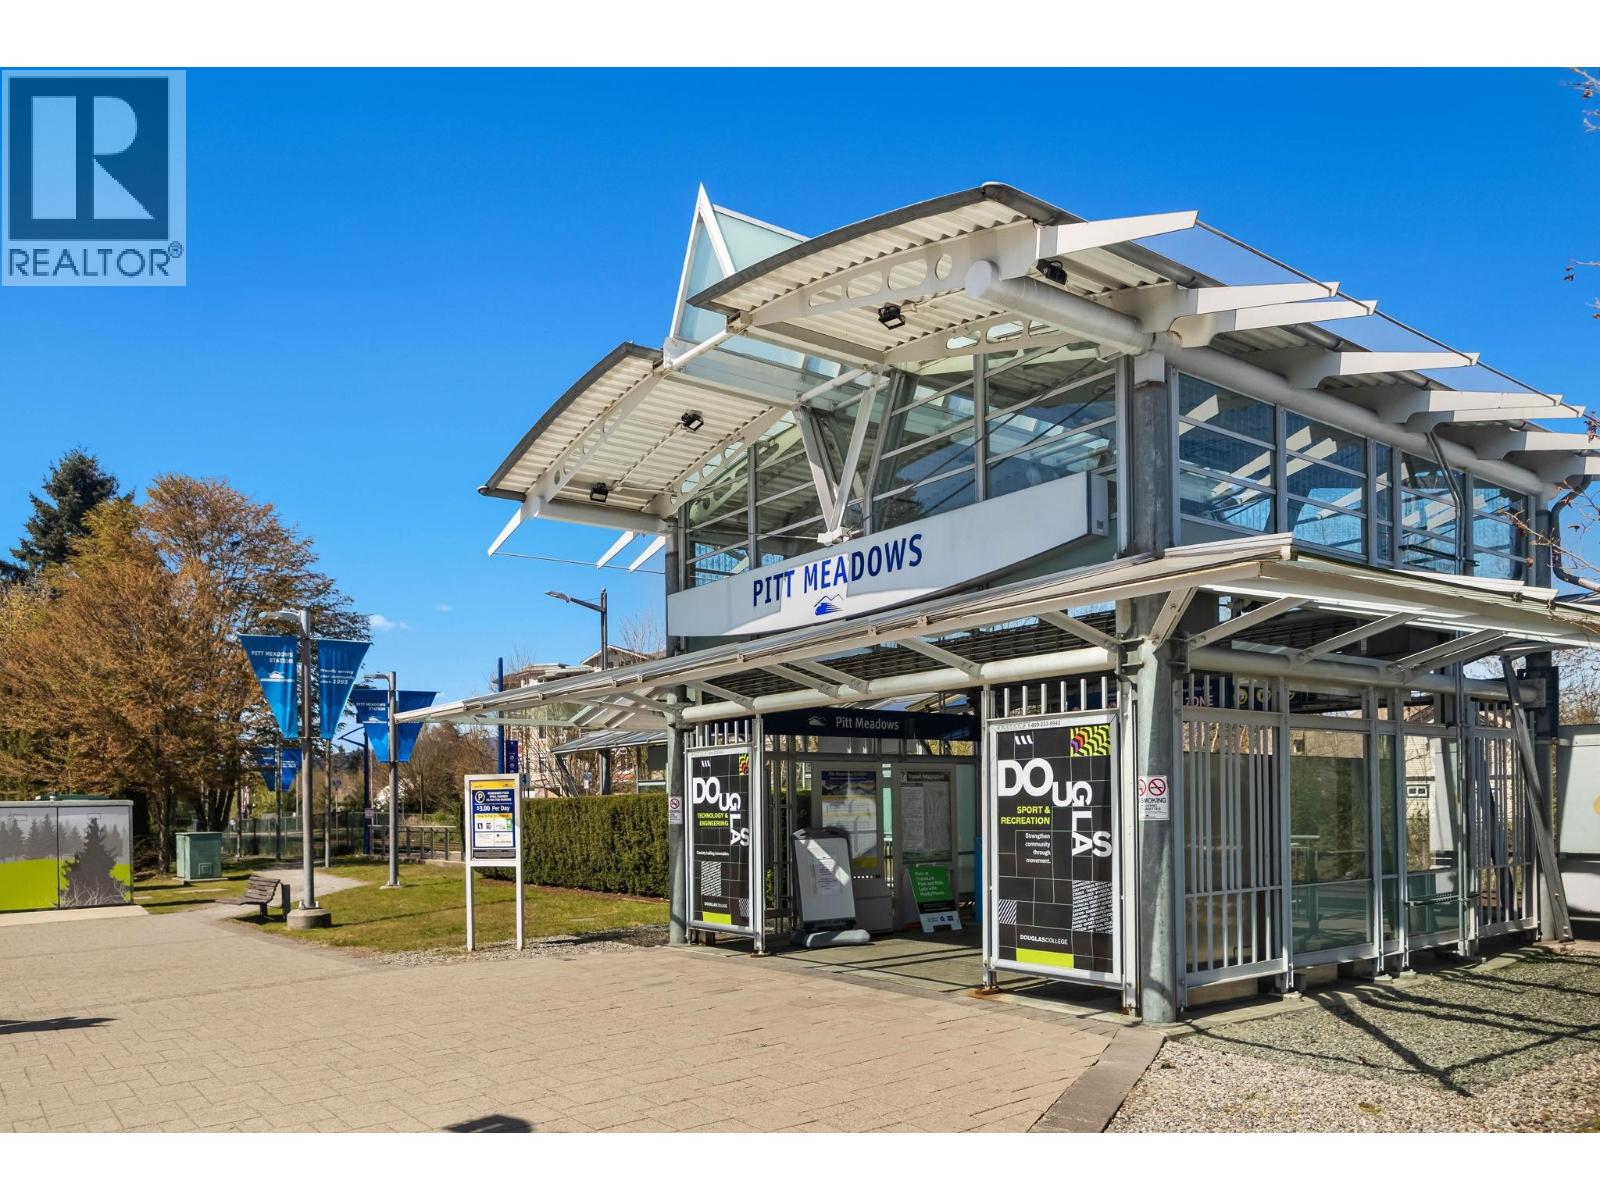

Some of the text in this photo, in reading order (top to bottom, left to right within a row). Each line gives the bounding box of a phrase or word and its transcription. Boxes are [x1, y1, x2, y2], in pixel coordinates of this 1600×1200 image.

[753, 533, 923, 607] PITT MEADOWS
[265, 650, 294, 658] MEADOWS
[835, 715, 900, 730] Pitt Meadows
[1016, 805, 1051, 815] SPORT &
[1000, 816, 1051, 826] RECREATION
[1024, 832, 1051, 840] Strengthen
[1024, 841, 1051, 849] community
[1032, 849, 1051, 857] through
